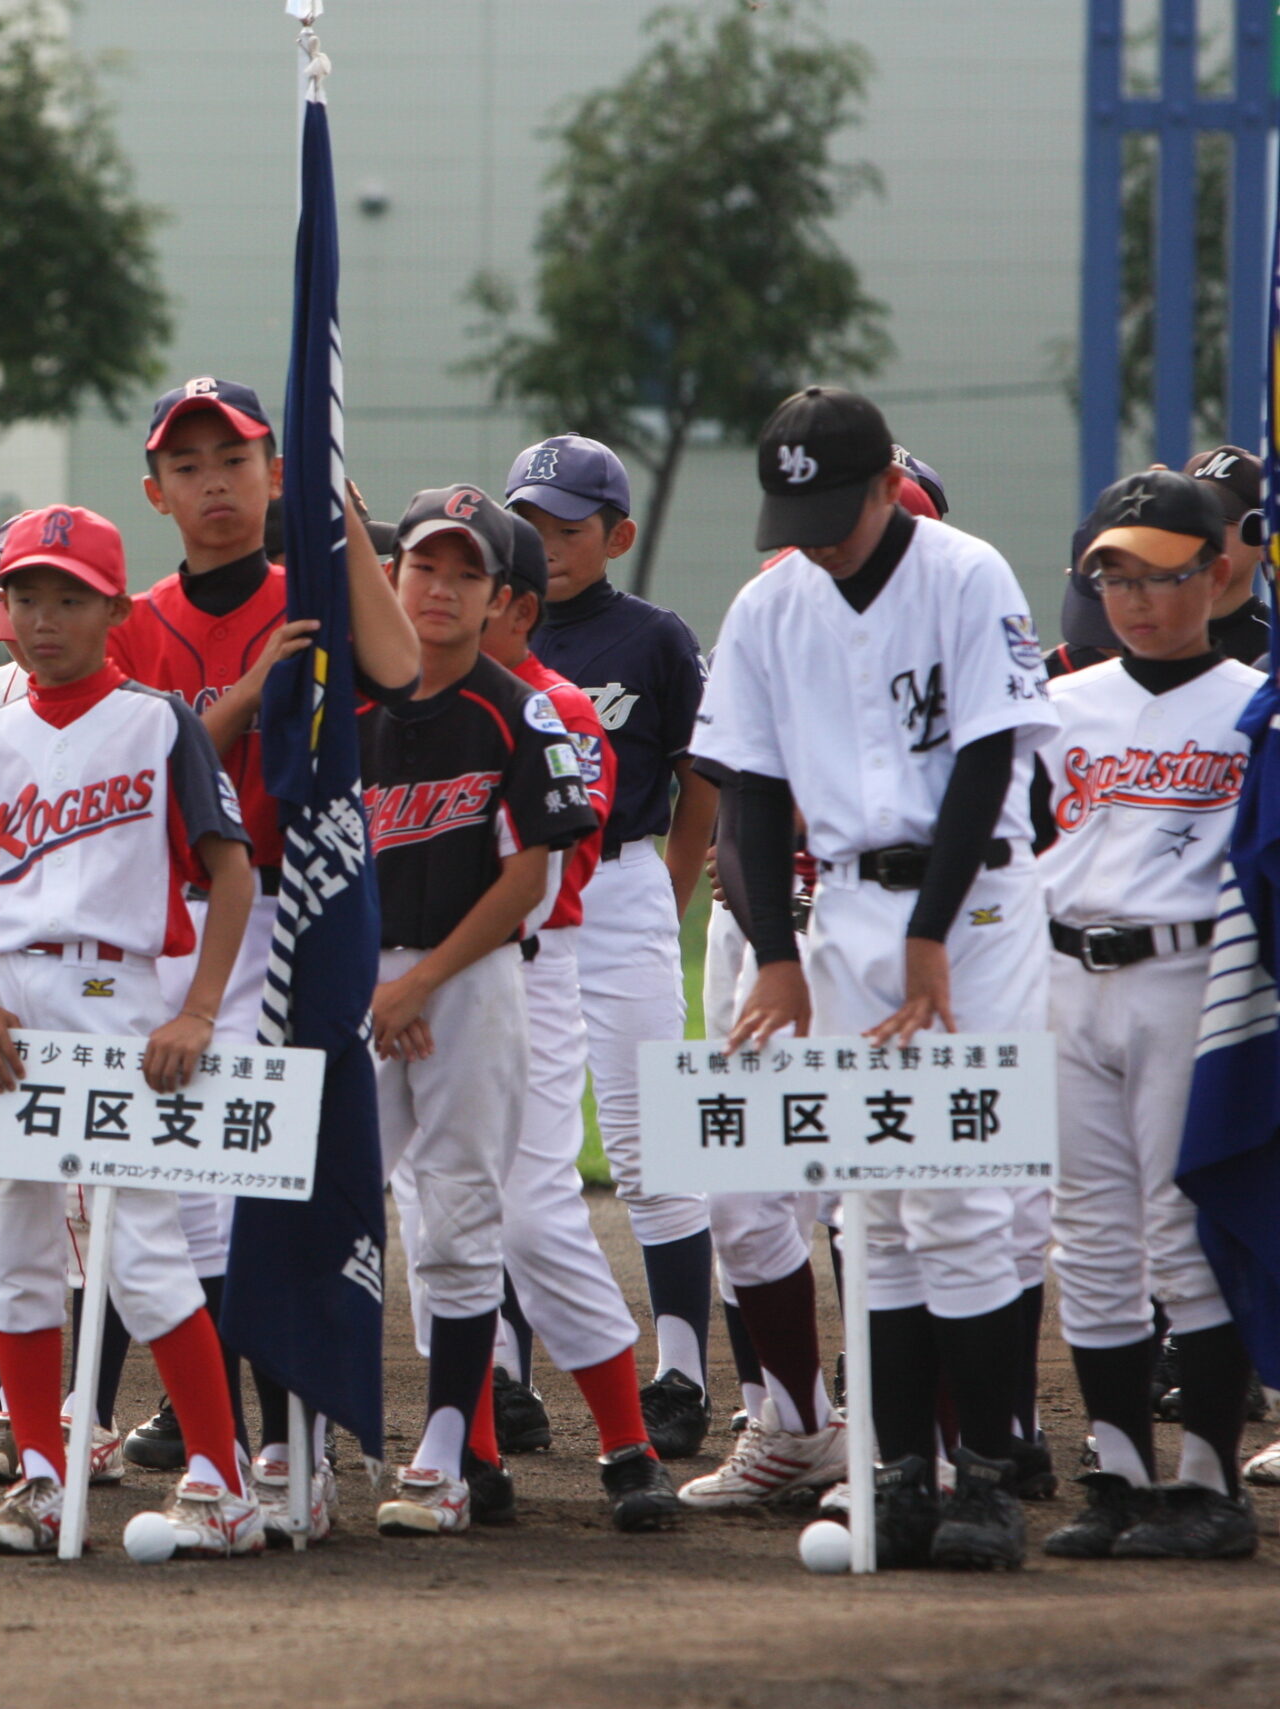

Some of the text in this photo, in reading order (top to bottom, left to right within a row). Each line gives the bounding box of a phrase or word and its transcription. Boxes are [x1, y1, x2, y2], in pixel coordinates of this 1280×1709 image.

[778, 445, 818, 483] MD
[1194, 452, 1240, 478] M
[445, 490, 482, 520] G
[41, 511, 72, 547] R
[676, 1044, 1020, 1075] 札幌市少年軟式野球連盟
[697, 1088, 1001, 1148] 南区支部
